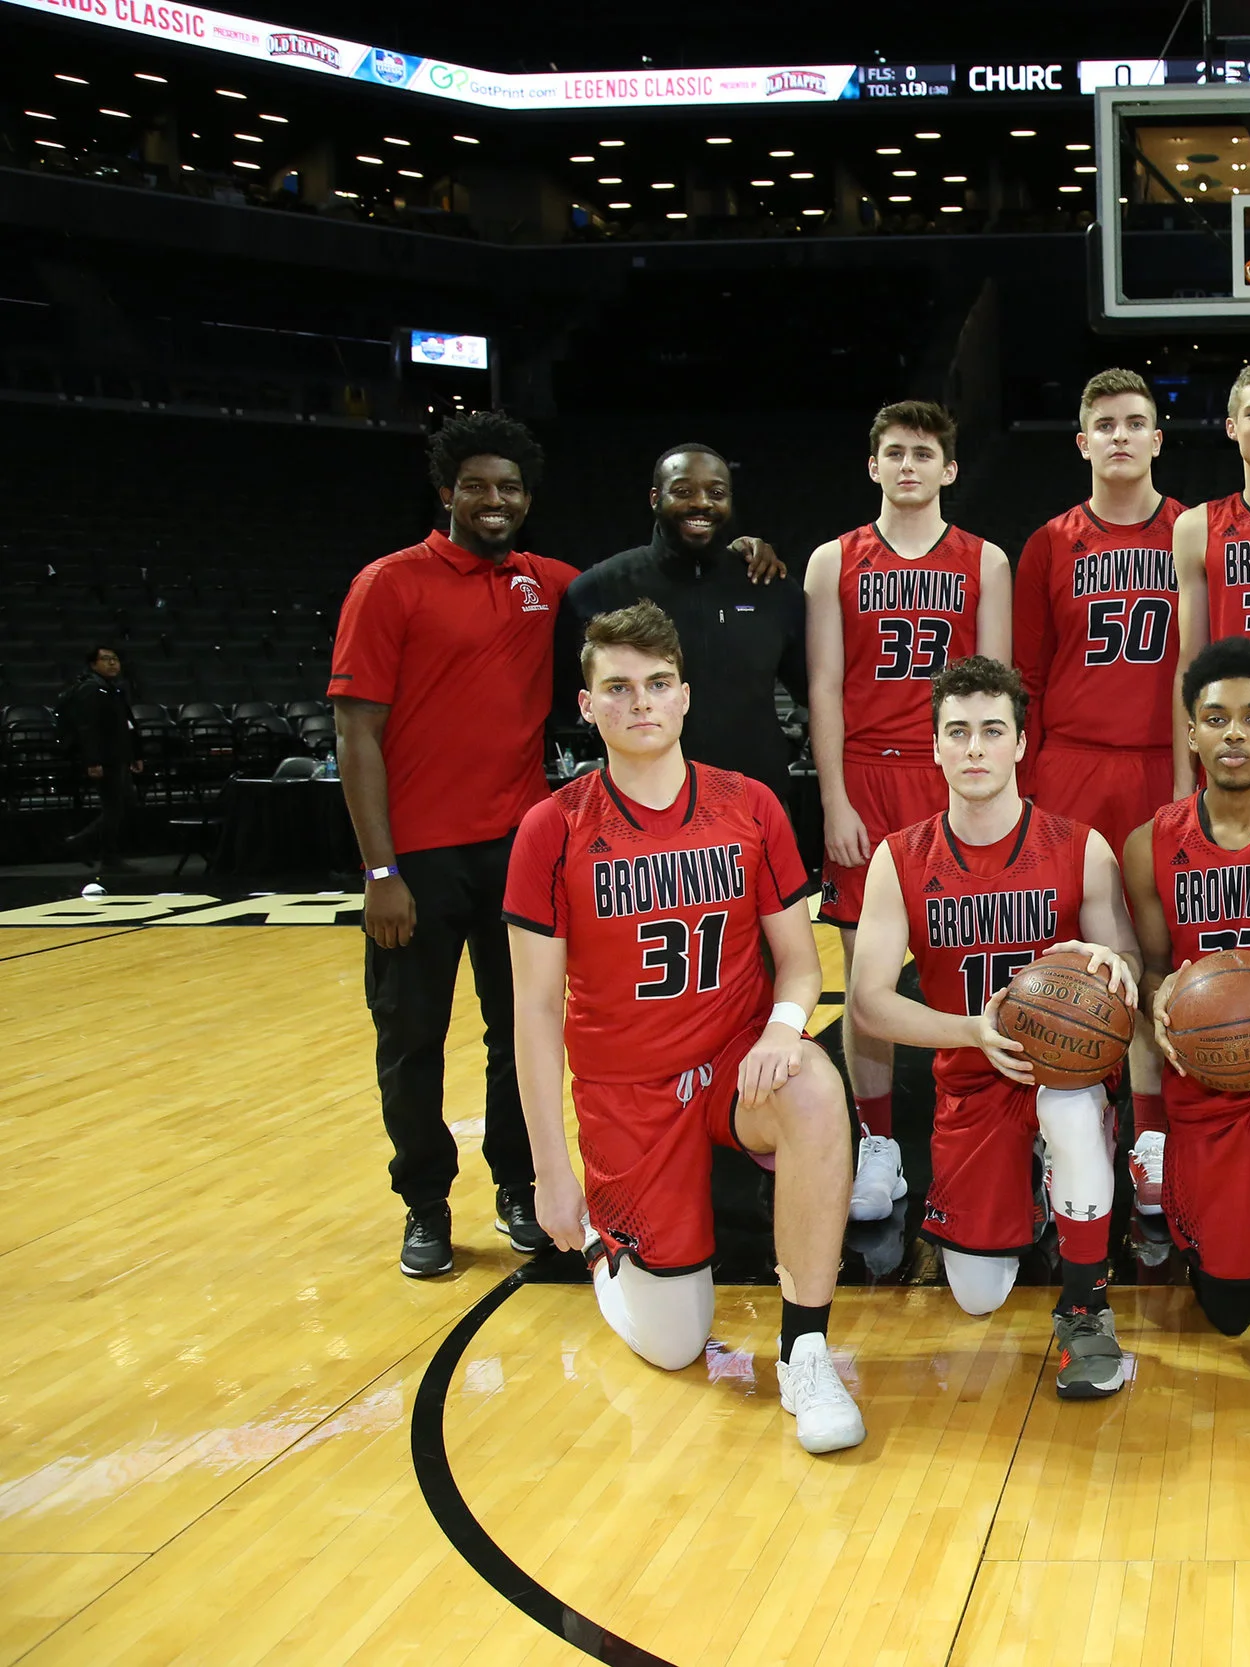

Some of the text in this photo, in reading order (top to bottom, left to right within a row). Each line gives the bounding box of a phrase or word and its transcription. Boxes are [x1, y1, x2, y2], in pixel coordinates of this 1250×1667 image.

[115, 0, 205, 37] CLASSIC
[564, 79, 639, 99] LEGENDS
[644, 76, 713, 97] CLASSIC
[867, 84, 897, 97] TOL:
[868, 66, 917, 81] FLS: 0
[969, 65, 1063, 91] CHURC
[858, 568, 966, 614] BROWNING
[1073, 548, 1179, 599] BROWNING
[875, 617, 952, 681] 33
[1085, 597, 1172, 666] 50
[593, 843, 745, 919] BROWNING
[926, 888, 1057, 948] BROWNING
[635, 910, 729, 1000] 31
[1013, 1011, 1105, 1059] SPALDING
